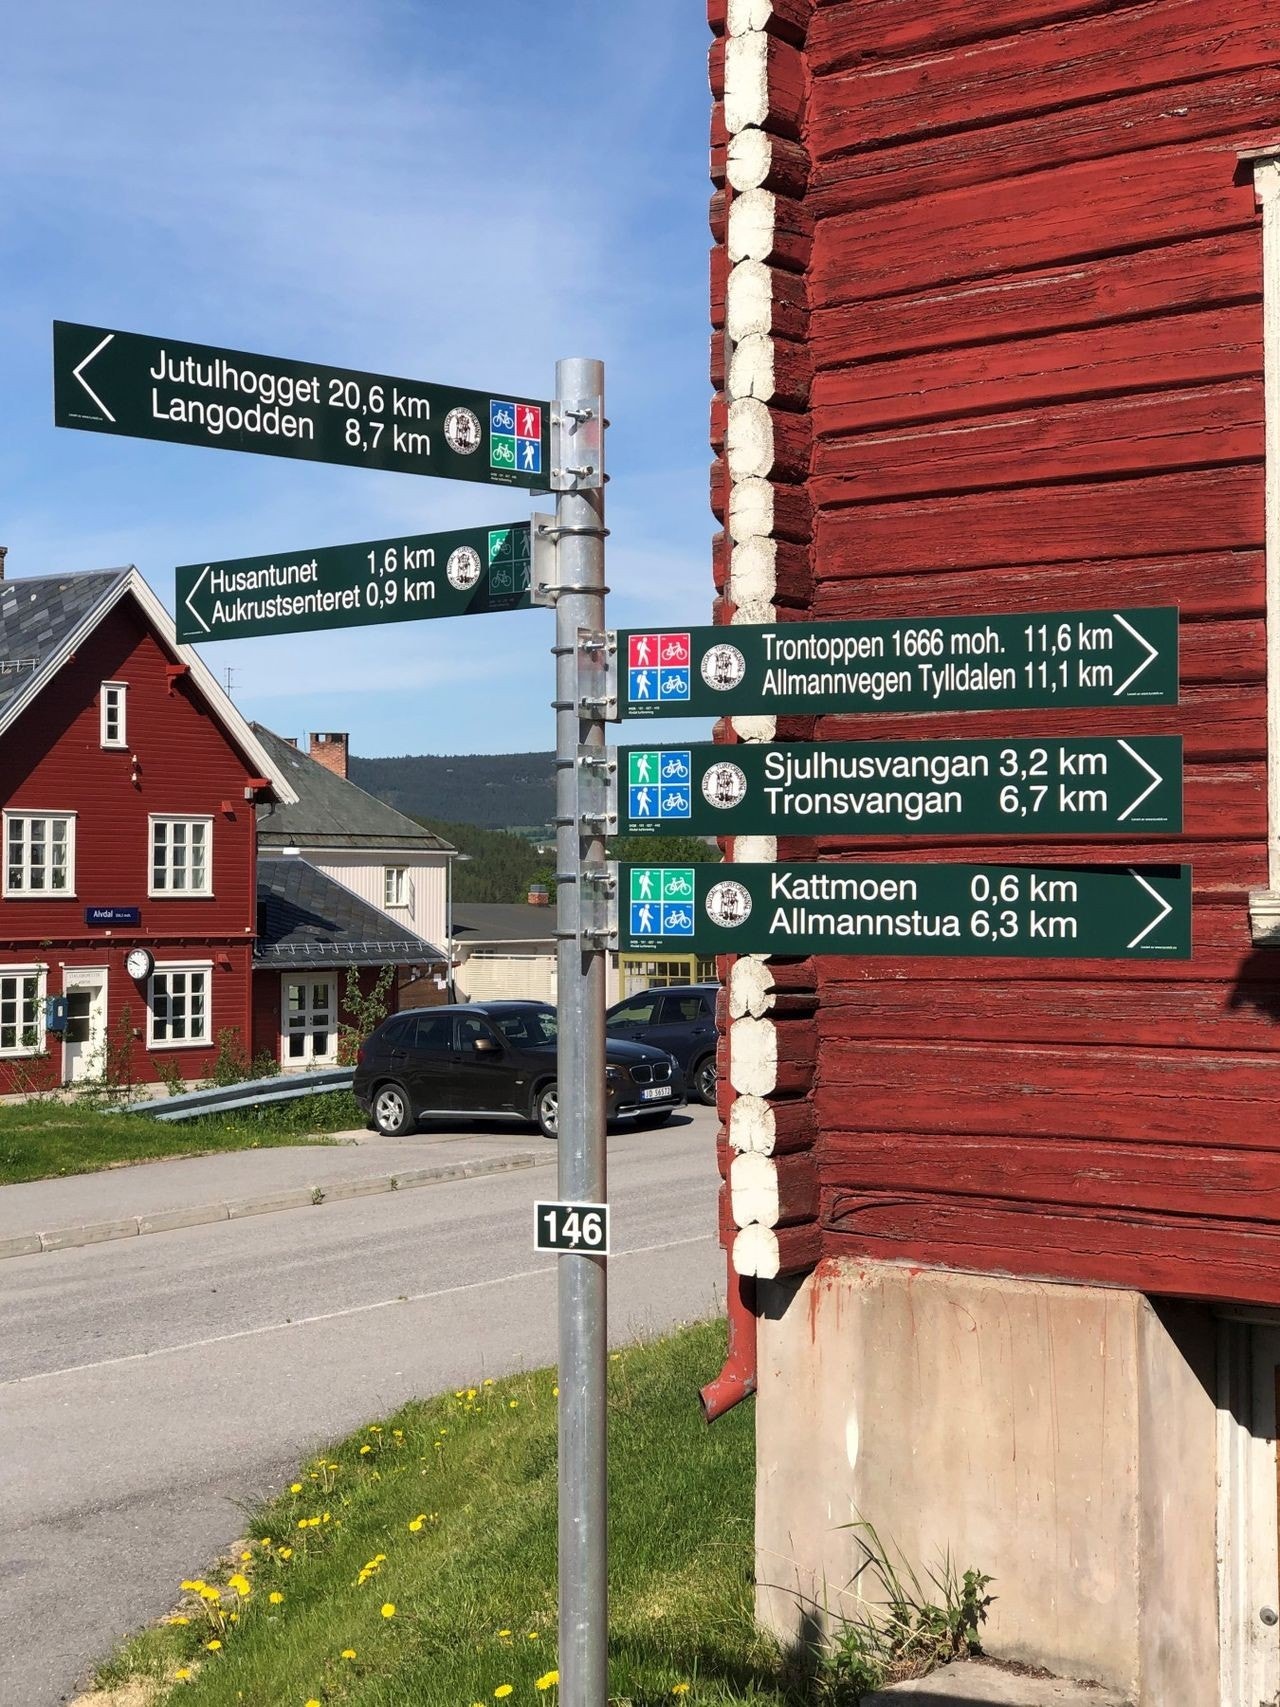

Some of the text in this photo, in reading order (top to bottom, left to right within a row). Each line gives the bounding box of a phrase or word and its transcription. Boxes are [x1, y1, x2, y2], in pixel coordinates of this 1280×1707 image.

[151, 349, 429, 420] Jutulhogget 20,6 km
[153, 387, 430, 456] Langodden 8,7 km
[211, 546, 434, 595] Husantunet 1,6 km
[212, 578, 434, 625] Aukrustsenteret 0,9 km
[763, 622, 1112, 666] Trontoppen 1666 moh. 11,6 km
[762, 659, 1112, 701] Allmannvegen Tylldalen 11,1 km
[764, 747, 1107, 787] Sjulhusvangan 3,2 km
[764, 783, 1107, 821] Tronsvangan 6,7 km
[771, 872, 1077, 907] Kattmoen 0,6 km
[93, 909, 113, 918] Alvdal
[769, 907, 1077, 942] Allmannstua 6,3 km
[543, 1210, 603, 1246] 146
